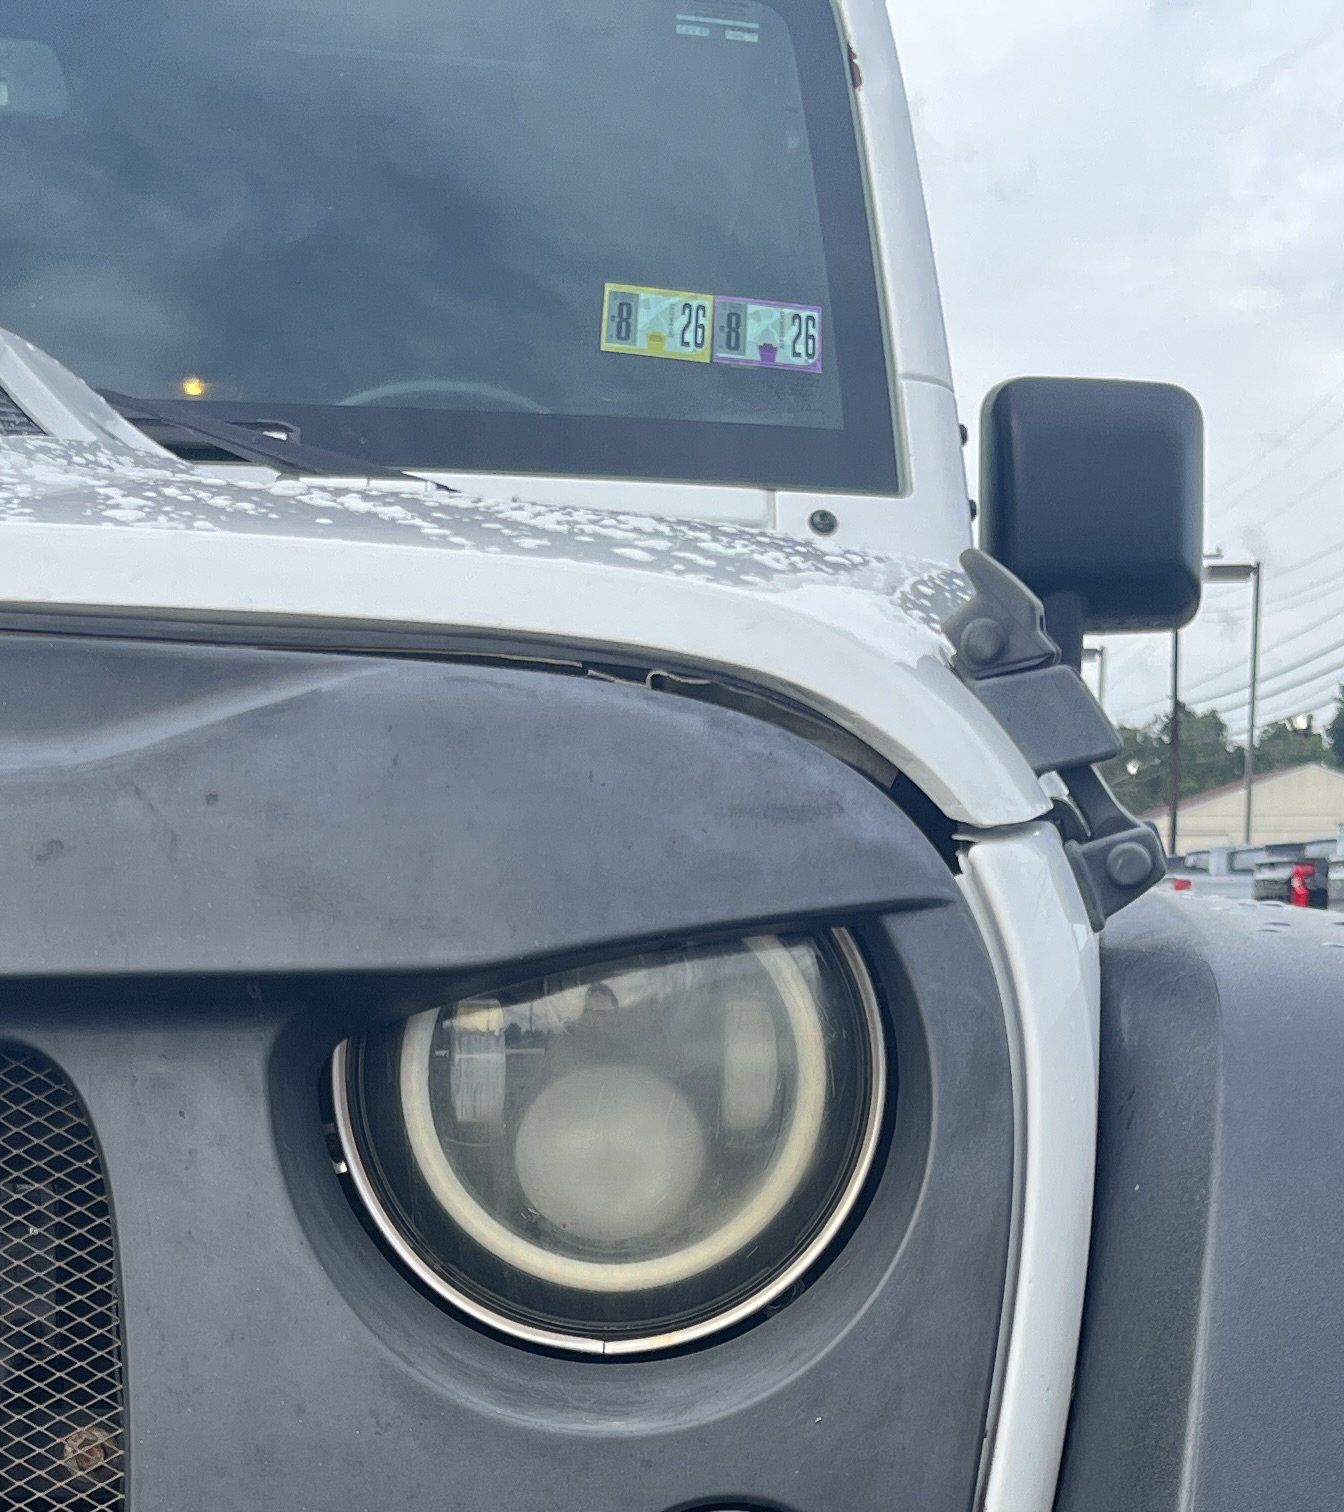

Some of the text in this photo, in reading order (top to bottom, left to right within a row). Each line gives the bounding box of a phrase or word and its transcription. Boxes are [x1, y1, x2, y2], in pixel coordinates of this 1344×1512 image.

[616, 302, 632, 341] 8
[681, 303, 706, 349] 26
[726, 312, 741, 351] 8
[792, 313, 816, 360] 26
